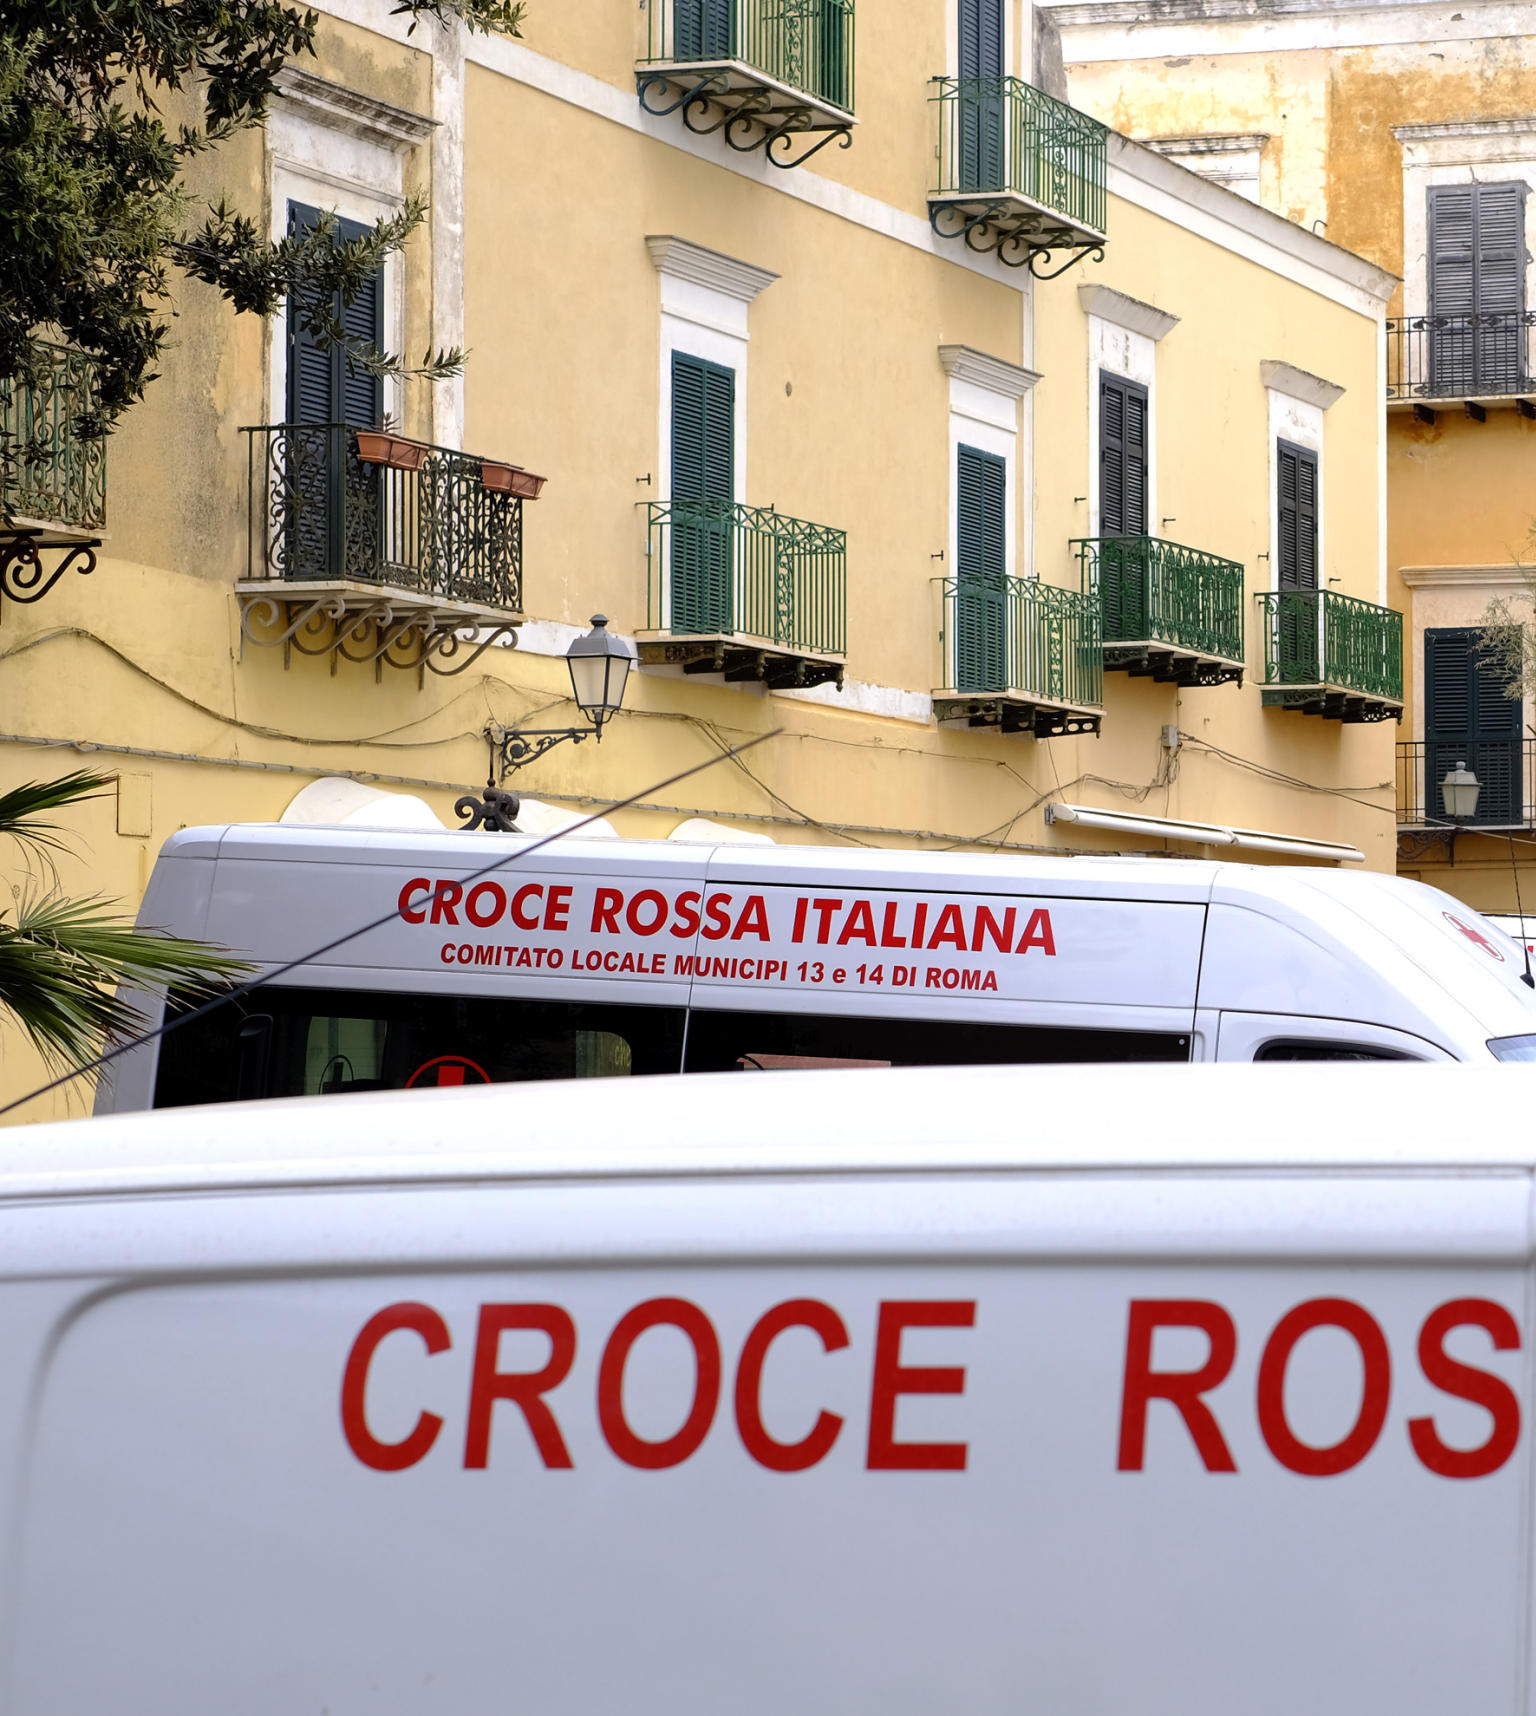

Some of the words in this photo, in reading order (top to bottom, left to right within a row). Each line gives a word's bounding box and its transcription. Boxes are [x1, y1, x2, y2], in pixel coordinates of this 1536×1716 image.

[398, 876, 574, 932] CROCE
[591, 887, 771, 942] ROSSA
[791, 897, 1057, 956] ITALIANA
[441, 943, 565, 969] COMITATO
[571, 949, 667, 974] LOCALE
[673, 954, 789, 982] MUNICIPI
[797, 961, 825, 983] 13
[832, 967, 847, 984] e
[856, 963, 884, 985] 14
[892, 965, 918, 987] DI
[925, 967, 999, 991] ROMA
[341, 1297, 977, 1473] CROCE
